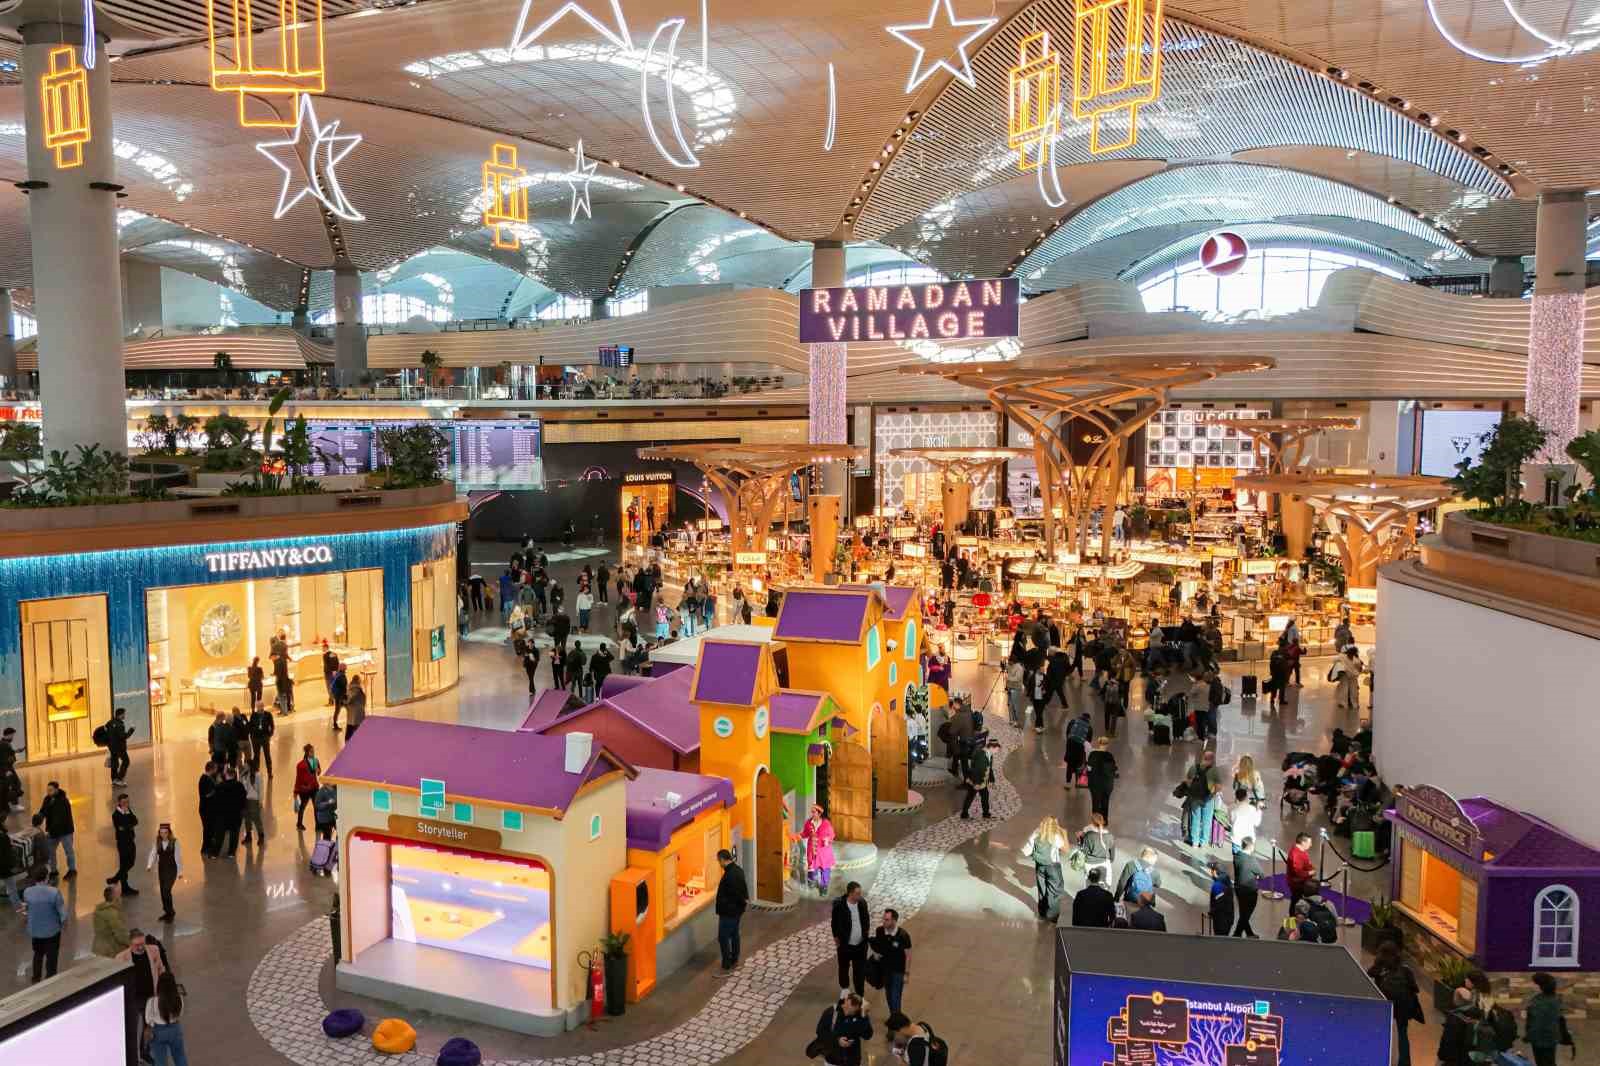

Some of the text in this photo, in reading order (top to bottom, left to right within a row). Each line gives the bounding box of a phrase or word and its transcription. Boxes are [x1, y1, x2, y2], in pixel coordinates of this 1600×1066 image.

[813, 281, 1001, 313] RAMADAN
[828, 311, 985, 341] VILLAGE
[625, 471, 672, 482] LOUIS VUITTON
[416, 822, 470, 840] Storyteller
[1407, 804, 1433, 828] POST
[1432, 819, 1466, 847] OFFICE
[1224, 1002, 1255, 1014] Airport
